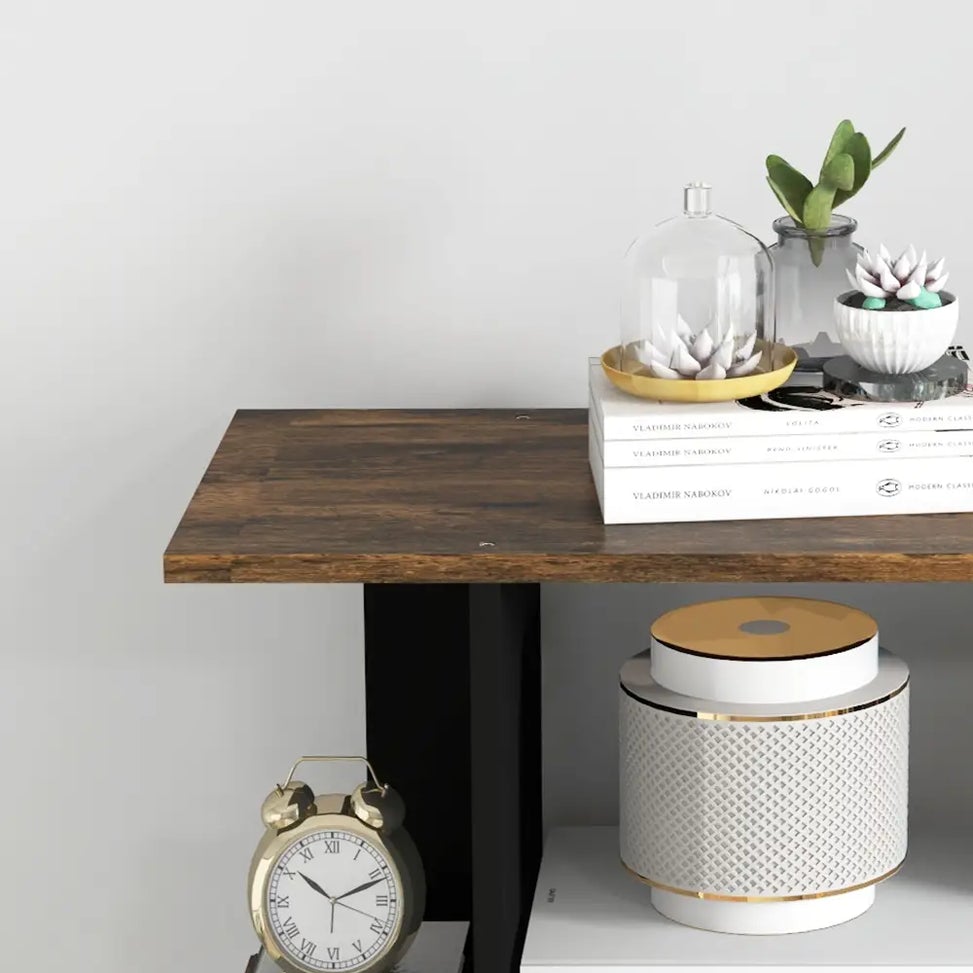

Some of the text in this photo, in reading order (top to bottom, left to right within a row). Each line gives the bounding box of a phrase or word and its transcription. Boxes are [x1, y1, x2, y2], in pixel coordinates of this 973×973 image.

[632, 421, 733, 432] VLADIMIR NABOKOV
[632, 447, 733, 458] VLADIMIR NABOKOV
[908, 483, 944, 491] MODERN
[632, 488, 733, 500] VLADIMIR NABOKOV
[324, 840, 340, 854] XII
[299, 847, 314, 863] XI
[283, 867, 296, 880] X
[277, 895, 289, 908] IX
[376, 895, 388, 907] III
[282, 916, 300, 939] VIII
[369, 917, 383, 935] IV
[300, 938, 317, 957] VII
[352, 939, 362, 954] V
[327, 947, 340, 960] VI
